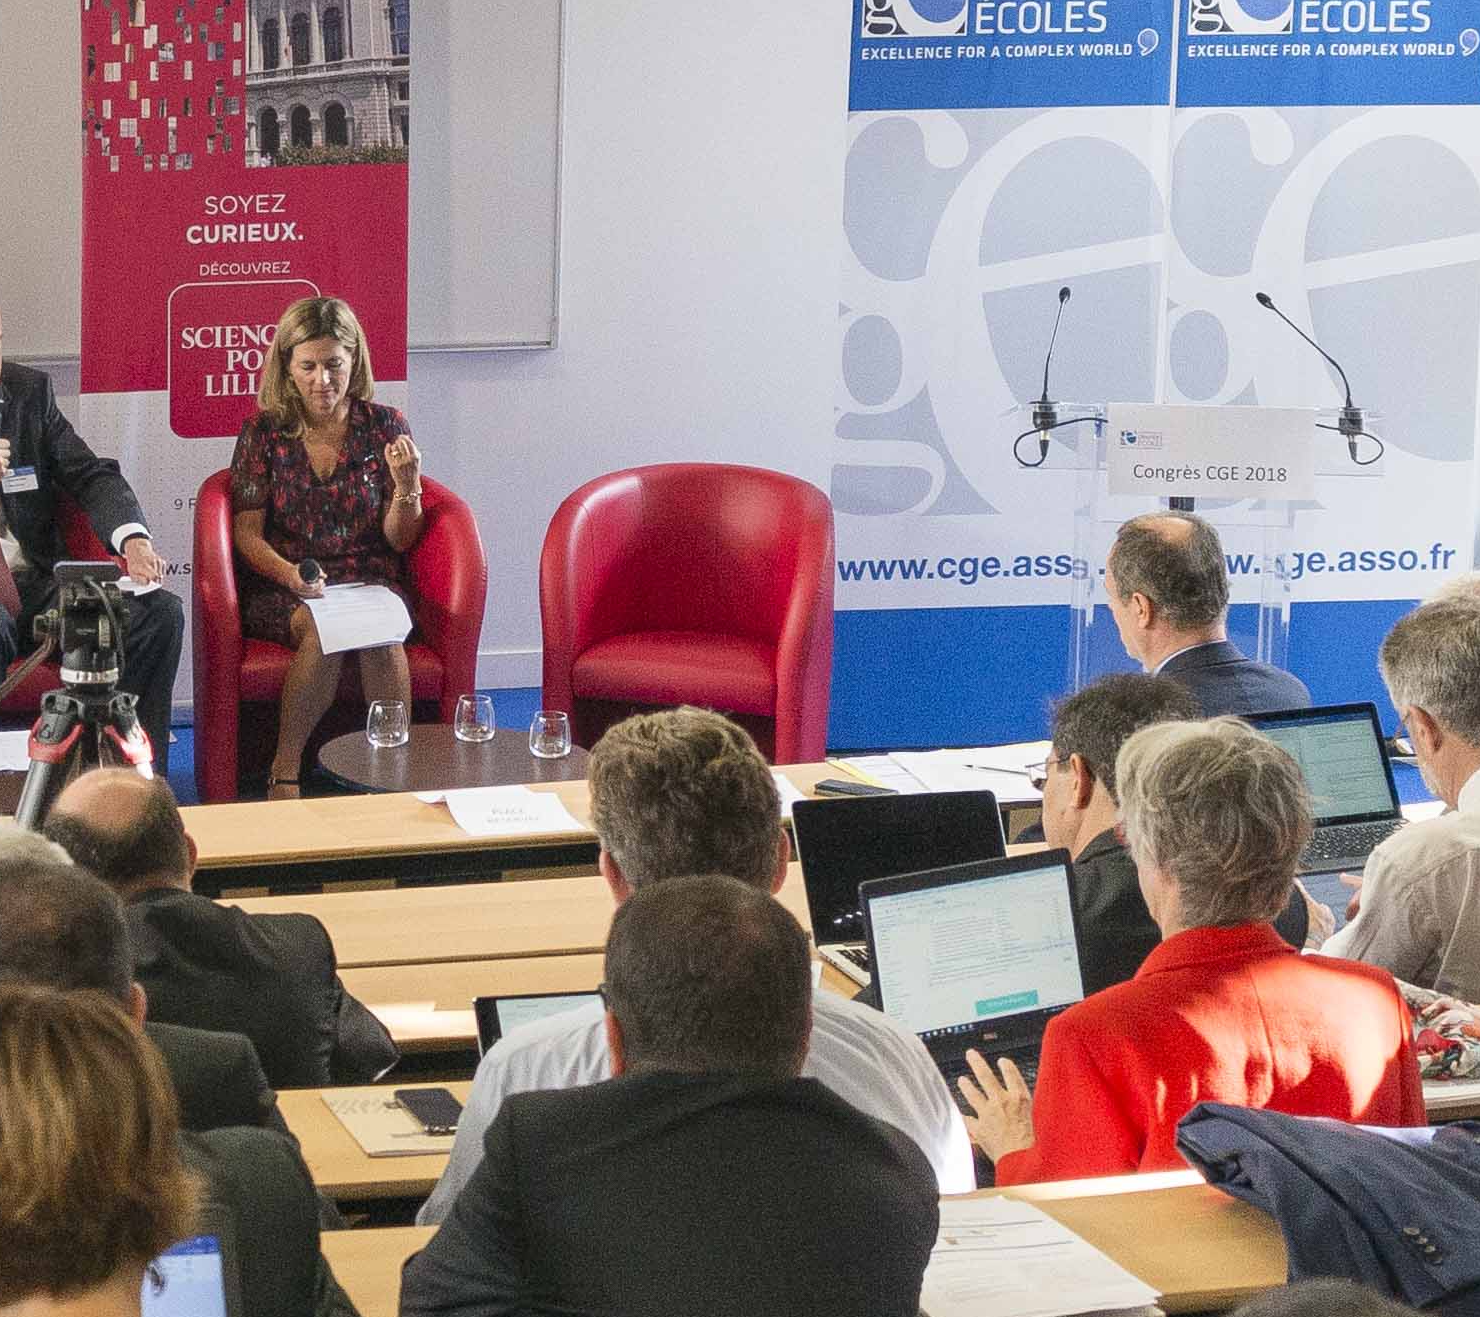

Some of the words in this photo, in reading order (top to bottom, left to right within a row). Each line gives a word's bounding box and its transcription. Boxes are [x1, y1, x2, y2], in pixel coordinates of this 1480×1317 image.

[861, 46, 952, 60] EXCELLENCE
[958, 46, 985, 59] FOR
[991, 46, 1000, 58] A
[1005, 45, 1074, 58] COMPLEX
[1079, 44, 1133, 57] WORLD
[1188, 45, 1277, 57] EXCELLENCE
[1283, 45, 1311, 57] FOR
[1316, 45, 1325, 57] A
[1330, 44, 1398, 57] COMPLEX
[1403, 44, 1455, 56] WORLD
[205, 194, 286, 214] SOYEZ
[186, 223, 304, 244] CURIEUX.
[199, 261, 290, 276] DÉCOUVREZ
[181, 324, 278, 349] SCIENC
[226, 349, 263, 372] PO
[1133, 464, 1201, 482] Congrès
[1206, 466, 1239, 480] CGE
[1245, 466, 1287, 482] 2018
[173, 499, 182, 511] 9
